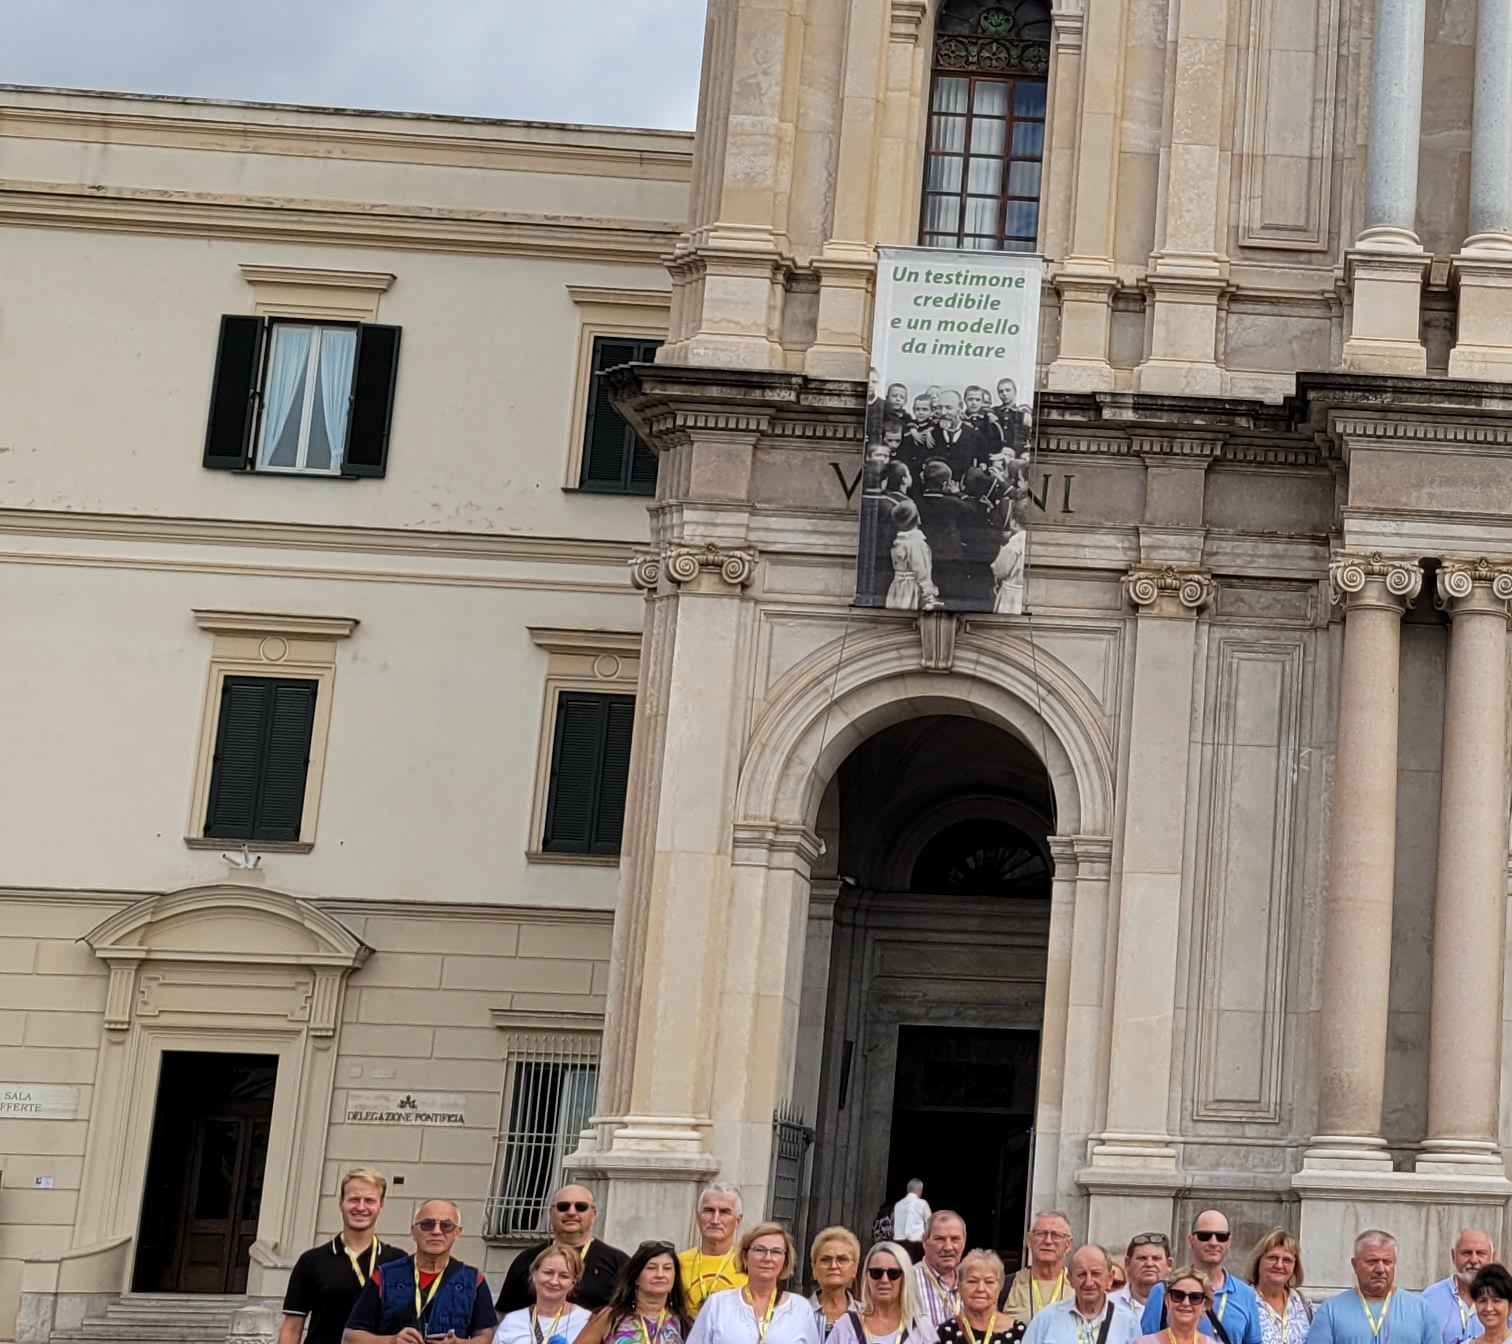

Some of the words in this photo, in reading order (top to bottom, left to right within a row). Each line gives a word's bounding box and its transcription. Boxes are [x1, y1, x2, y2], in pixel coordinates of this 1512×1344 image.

[892, 266, 920, 283] Un
[924, 269, 1026, 289] testimone
[913, 292, 1001, 311] credibile
[890, 317, 902, 329] e
[906, 317, 932, 331] un
[937, 318, 1020, 336] modello
[901, 337, 927, 355] da
[931, 338, 1006, 359] imitare
[4, 1091, 31, 1101] SALA
[347, 1111, 413, 1123] DELEGAZIONE
[414, 1112, 465, 1124] PONTIFICIA
